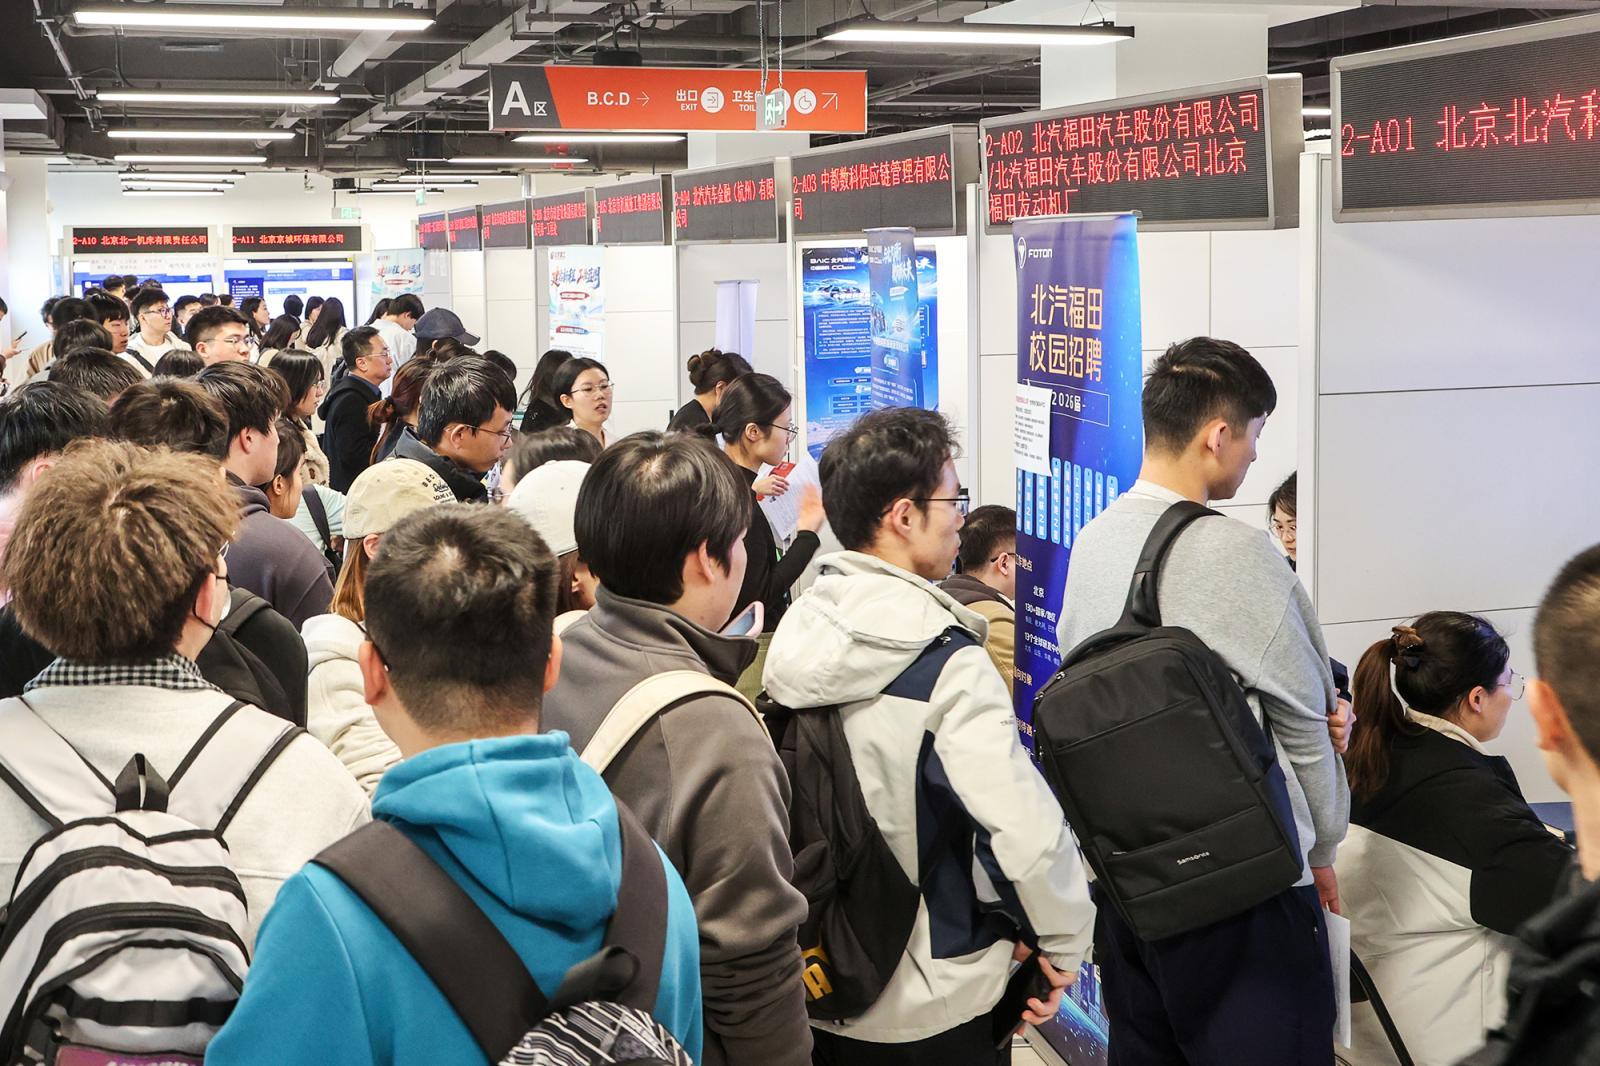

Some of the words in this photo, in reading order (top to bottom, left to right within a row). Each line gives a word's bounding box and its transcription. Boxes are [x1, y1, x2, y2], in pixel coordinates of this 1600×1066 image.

[587, 91, 630, 106] B.C.D
[676, 89, 697, 102] 出口
[985, 129, 1024, 157] 2-A02
[1032, 94, 1258, 155] 北汽福田汽车股份有限公司
[1342, 117, 1415, 156] 2-A01
[792, 174, 817, 194] 2-A03
[794, 197, 803, 220] 司
[989, 188, 1079, 223] 福田发动机厂
[101, 235, 207, 246] 北京北一机床有限责任公司
[1028, 248, 1053, 259] FOTON
[1030, 283, 1103, 331] 北汽福田
[1029, 330, 1103, 383] 校园招聘
